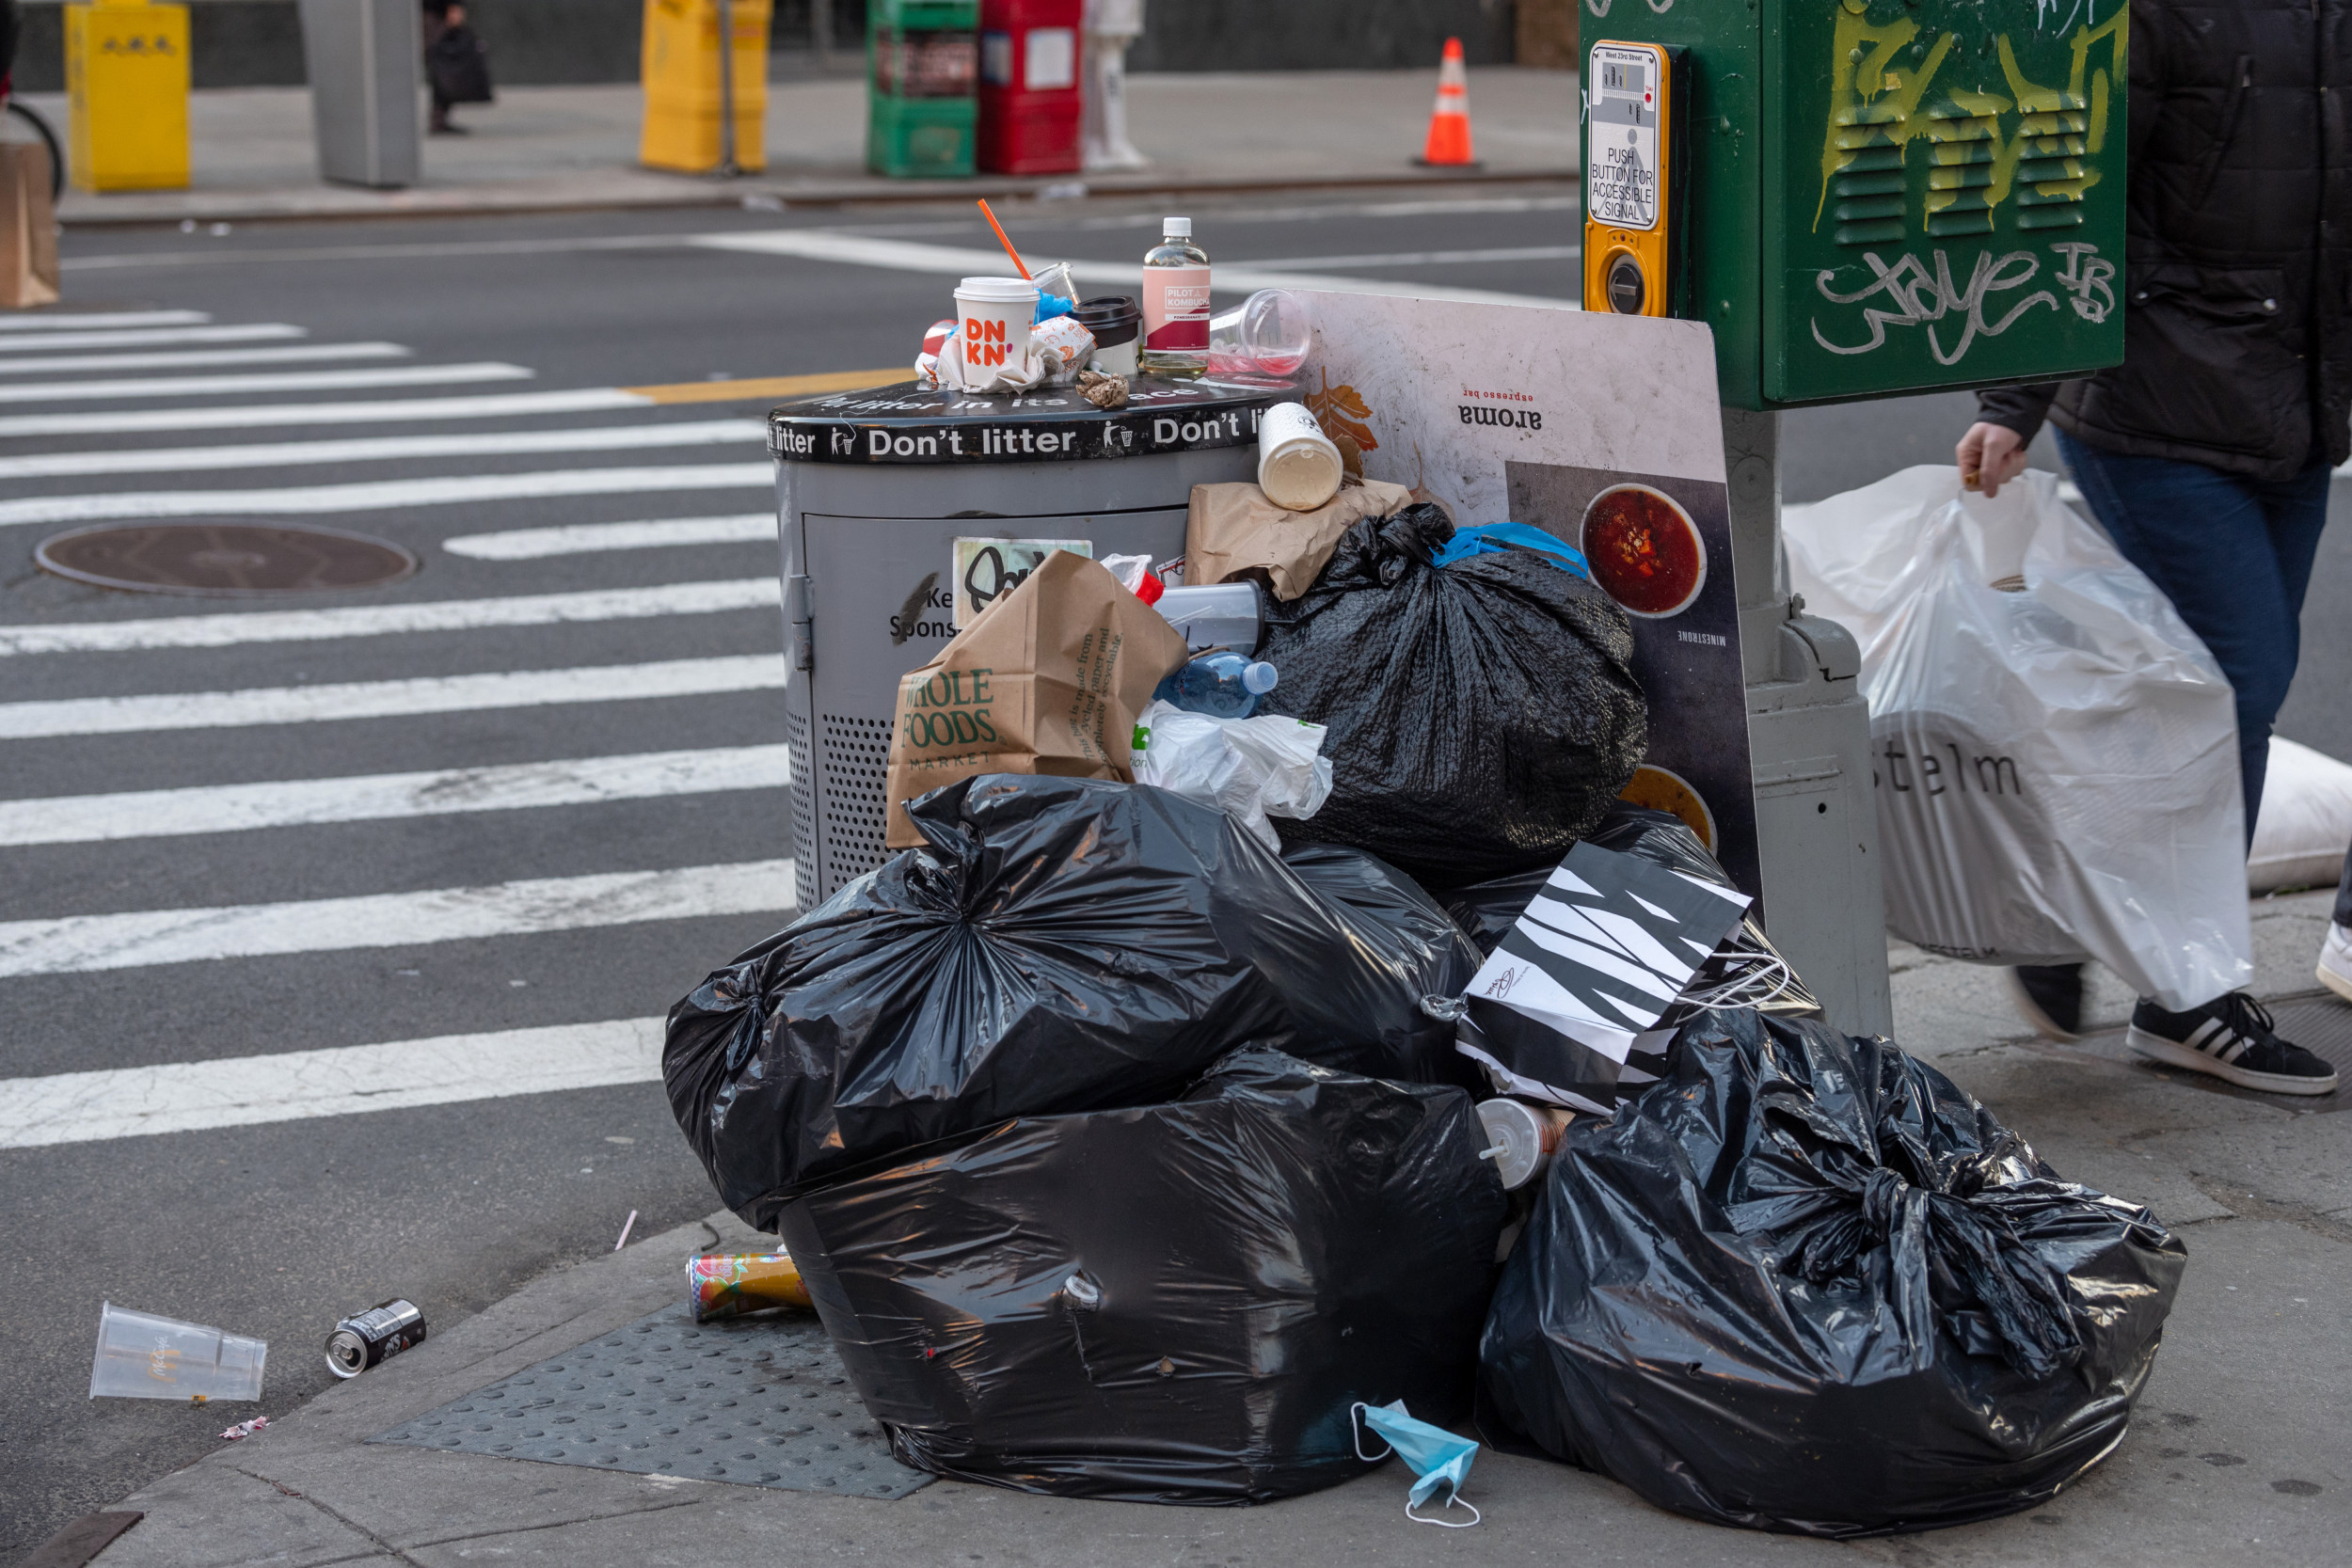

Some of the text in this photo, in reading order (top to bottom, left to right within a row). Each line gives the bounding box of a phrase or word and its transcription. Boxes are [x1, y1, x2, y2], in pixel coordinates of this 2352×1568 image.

[1608, 147, 1634, 165] PUSH
[1592, 164, 1653, 185] BUTTON FOR
[1592, 182, 1652, 204] ACCESSIBLE
[1604, 200, 1639, 220] SIGNAL
[1168, 289, 1193, 297] PILOT
[966, 317, 1005, 343] DN
[951, 400, 993, 409] in
[1011, 398, 1069, 407] its
[1127, 388, 1199, 401] ace
[1463, 389, 1534, 403] espresso bar
[1457, 404, 1542, 431] aroma
[776, 425, 816, 453] litter
[868, 429, 963, 456] Don't
[982, 428, 1076, 455] litter
[1153, 412, 1240, 445] Don't
[889, 615, 962, 642] Spons
[1677, 630, 1725, 647] MINESTRONE
[1076, 633, 1093, 664] from
[1081, 694, 1096, 734] ycled
[1098, 627, 1110, 653] and
[1069, 704, 1080, 715] is
[1078, 738, 1095, 760] This
[910, 751, 990, 771] MARKET
